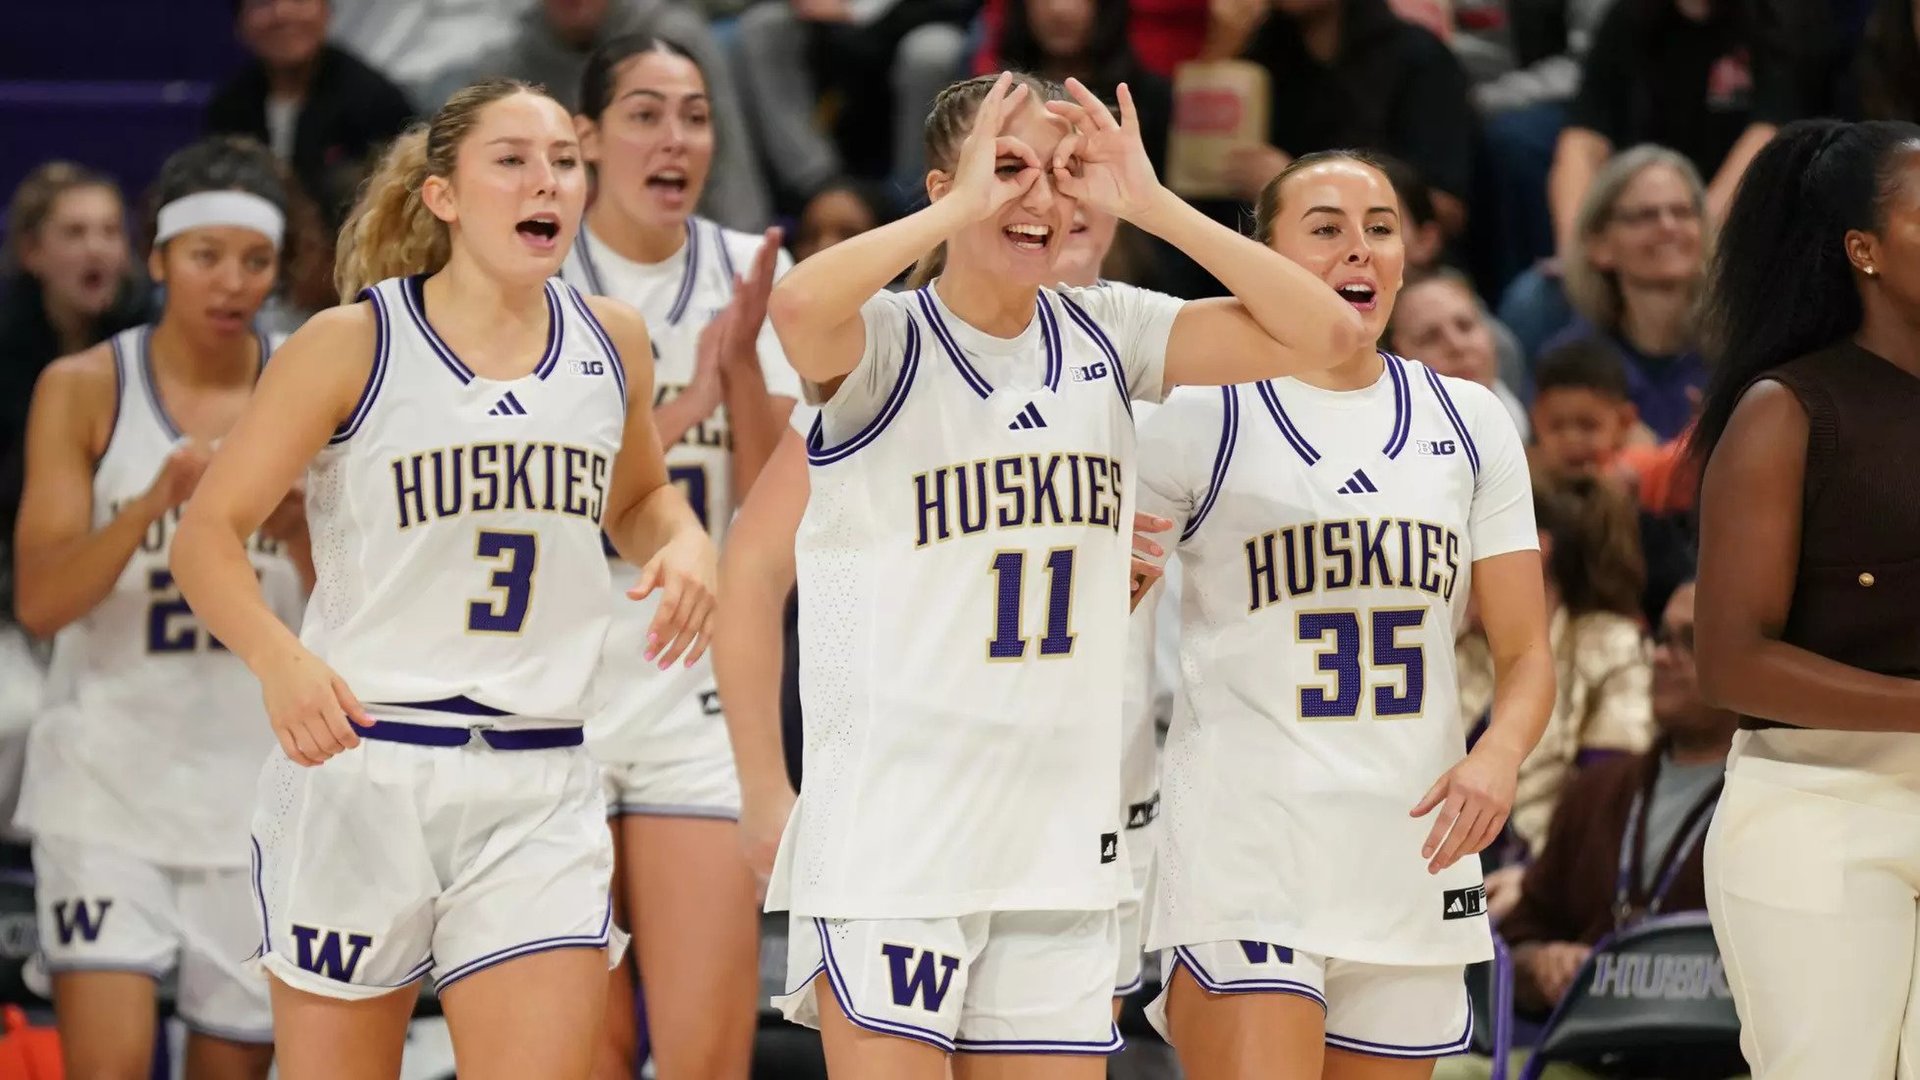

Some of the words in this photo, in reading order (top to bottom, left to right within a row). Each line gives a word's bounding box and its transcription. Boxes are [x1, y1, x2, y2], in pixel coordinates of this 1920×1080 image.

[391, 441, 607, 529] HUSKIES
[912, 452, 1122, 549] HUSKIES
[465, 527, 540, 636] 3
[986, 546, 1078, 663] 11
[1244, 517, 1461, 614] HUSKIES
[1295, 604, 1430, 722] 35
[53, 898, 113, 945] W
[289, 922, 374, 984] W
[880, 941, 962, 1015] W
